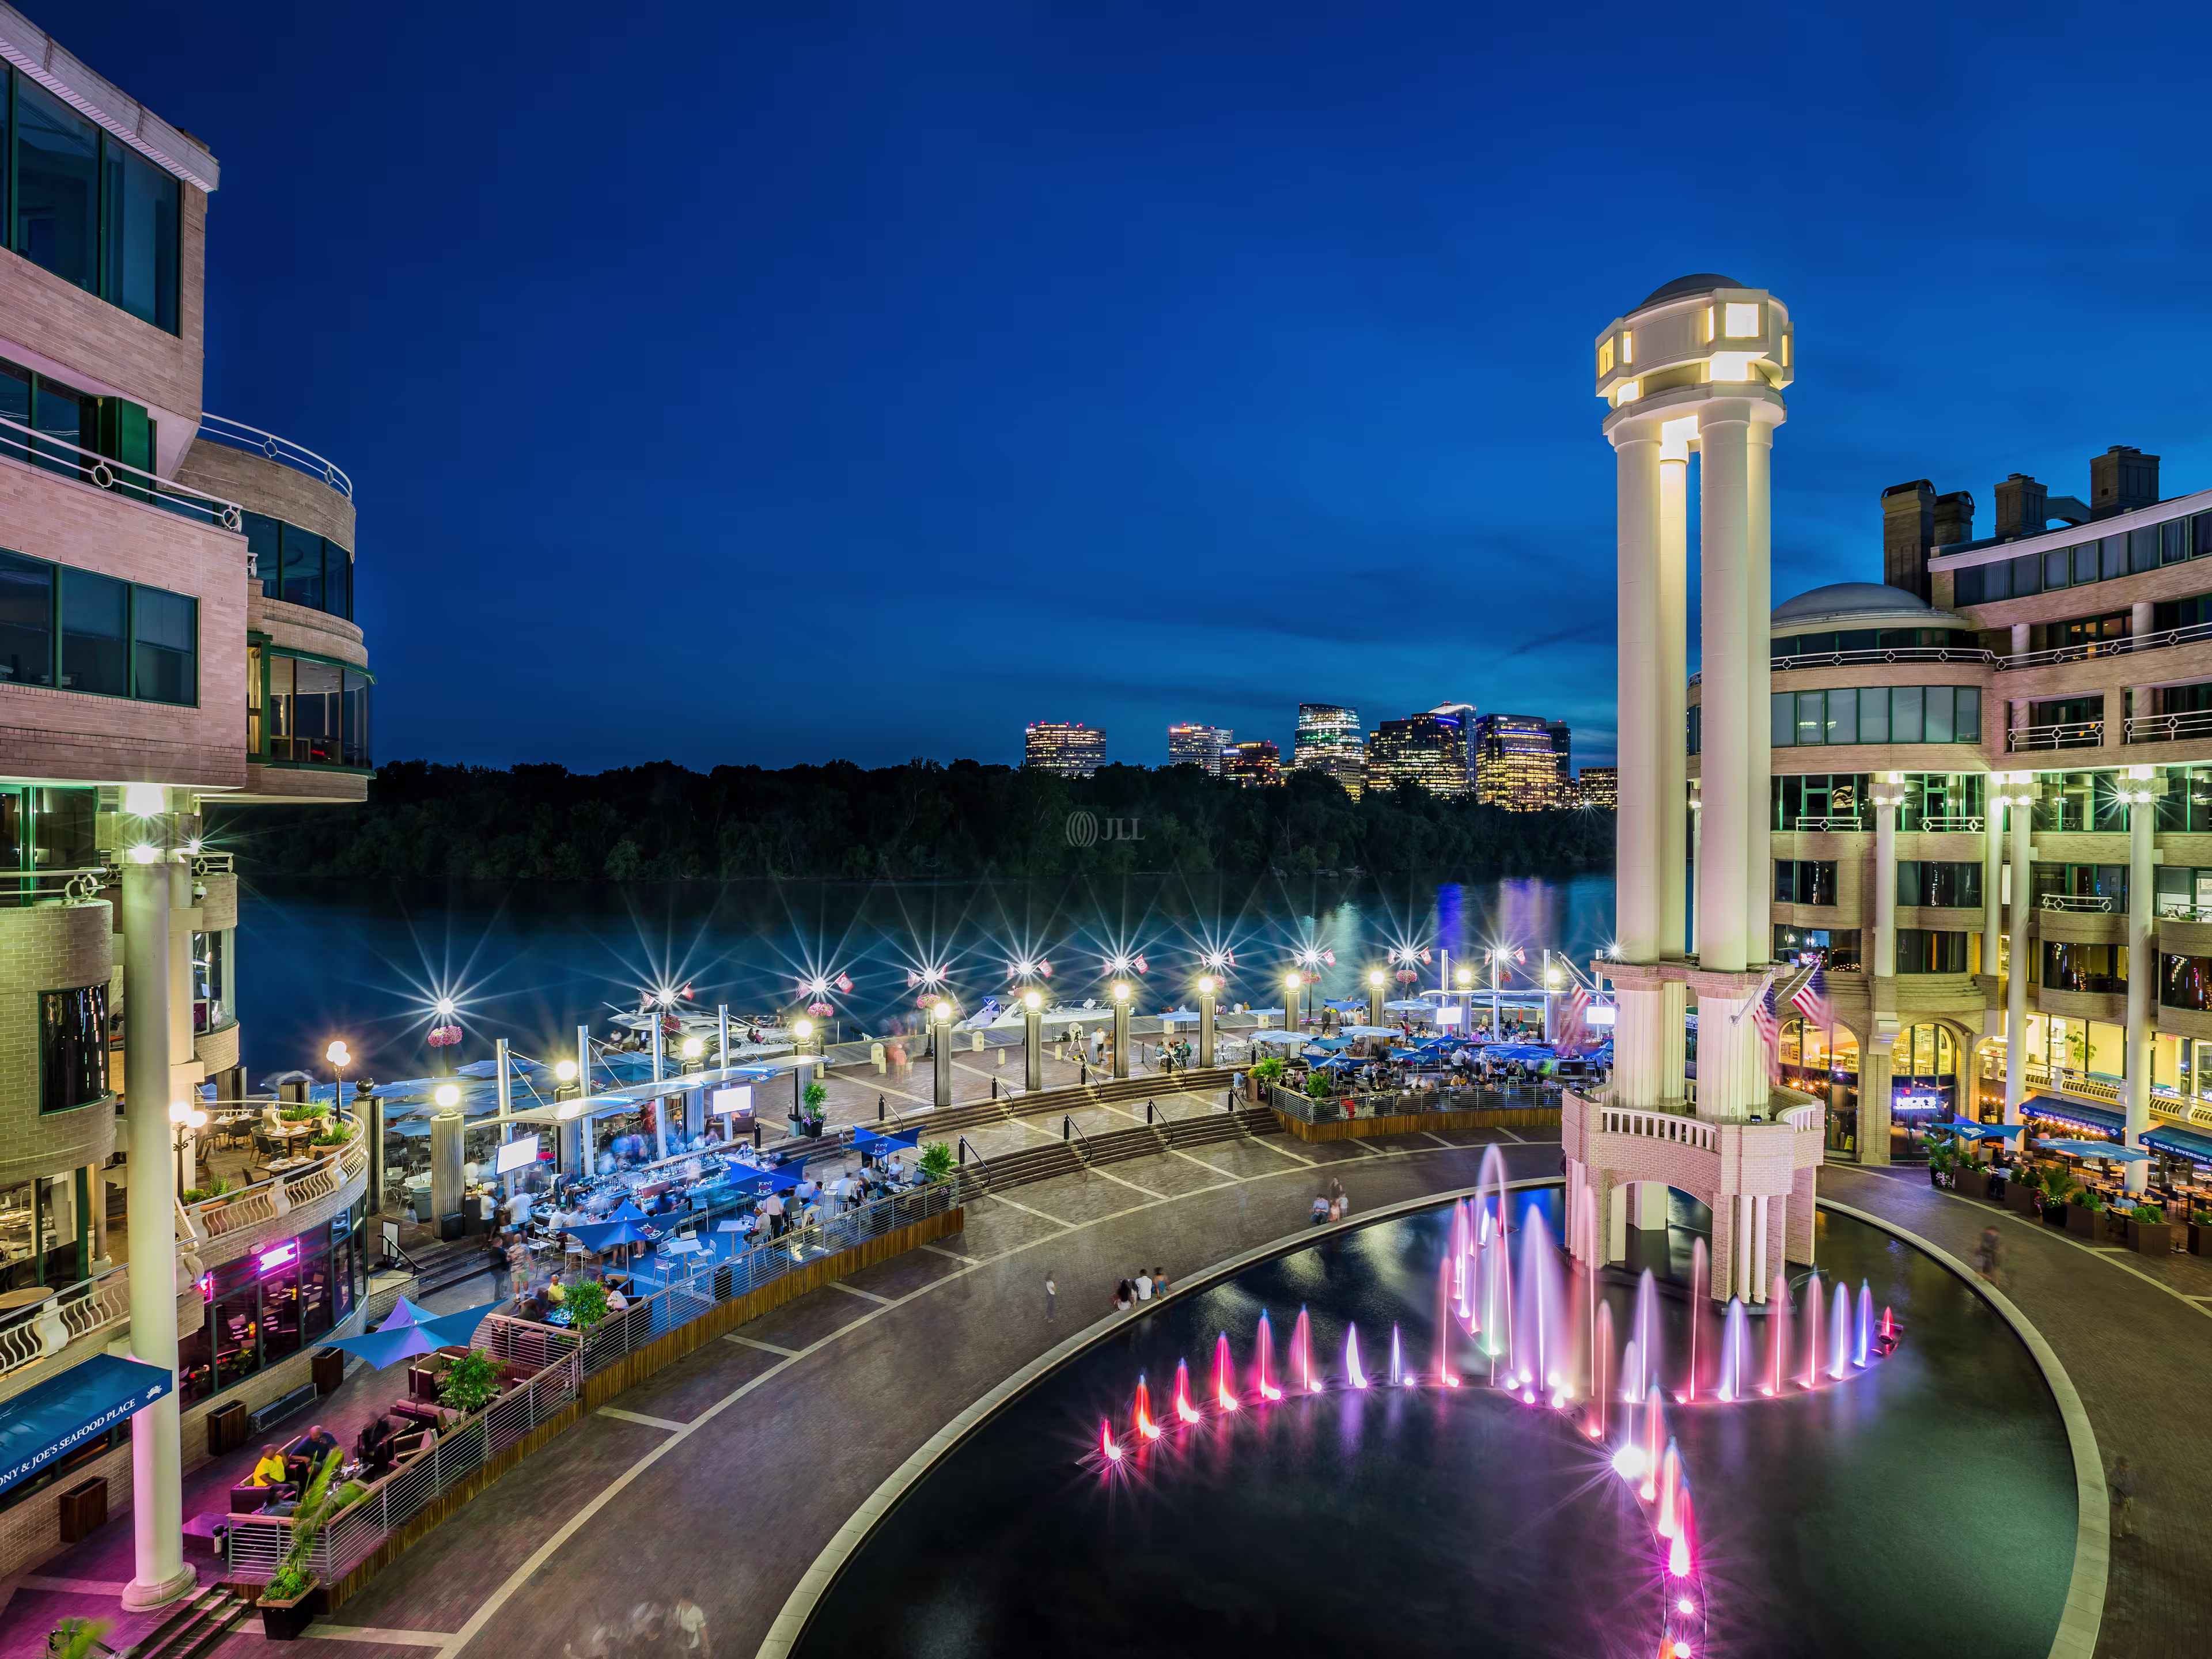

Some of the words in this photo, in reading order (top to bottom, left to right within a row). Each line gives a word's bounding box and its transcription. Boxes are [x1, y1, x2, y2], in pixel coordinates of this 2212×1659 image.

[2154, 1142, 2174, 1152] NICK'S
[2175, 1148, 2208, 1162] RIVERSIDE
[21, 1461, 30, 1472] &
[32, 1444, 58, 1468] JOE'S
[59, 1416, 105, 1450] SEAFOOD
[106, 1399, 135, 1422] PLACE
